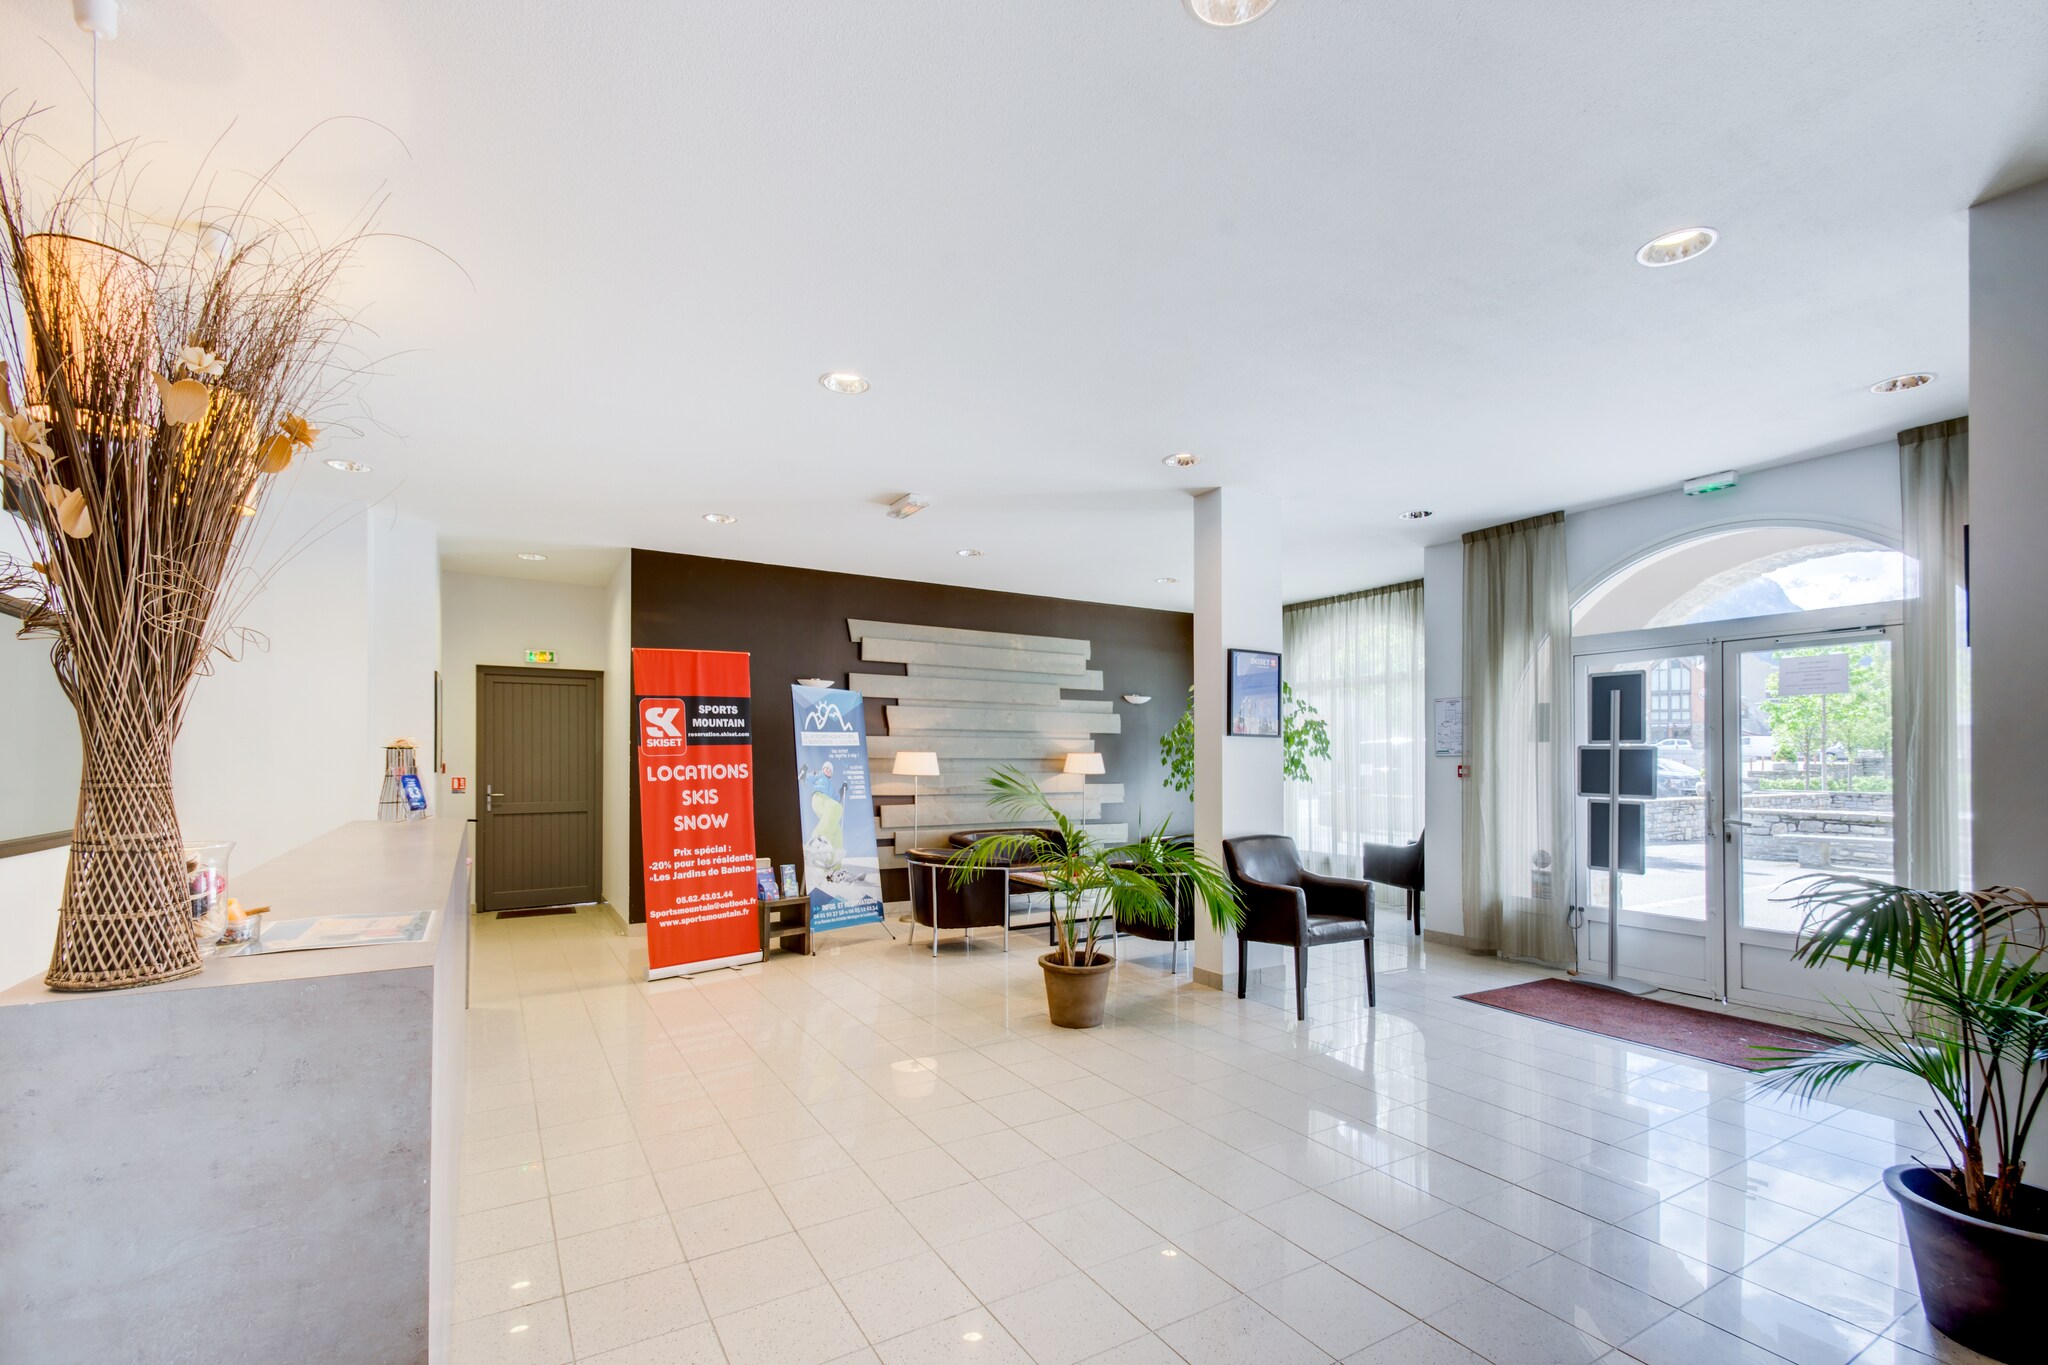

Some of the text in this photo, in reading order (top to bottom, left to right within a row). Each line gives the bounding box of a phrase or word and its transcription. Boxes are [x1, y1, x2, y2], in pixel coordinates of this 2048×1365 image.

[698, 705, 738, 714] SPORTS
[692, 718, 745, 727] MOUNTAIN
[646, 738, 682, 747] SKISET
[646, 763, 749, 781] LOCATIONS
[682, 788, 719, 806] SKIS
[673, 813, 729, 832] SNOW
[673, 848, 692, 857] Prix
[694, 845, 727, 856] spécial
[649, 853, 754, 870] -20% pour les résidents
[672, 870, 706, 880] Jardins
[708, 867, 719, 876] de
[676, 890, 733, 904] 05.62.43.01.44
[649, 897, 757, 919] Sportsmountain@outlook.fr
[822, 903, 836, 911] INFOS
[659, 908, 750, 928] www.sportsmountain.fr
